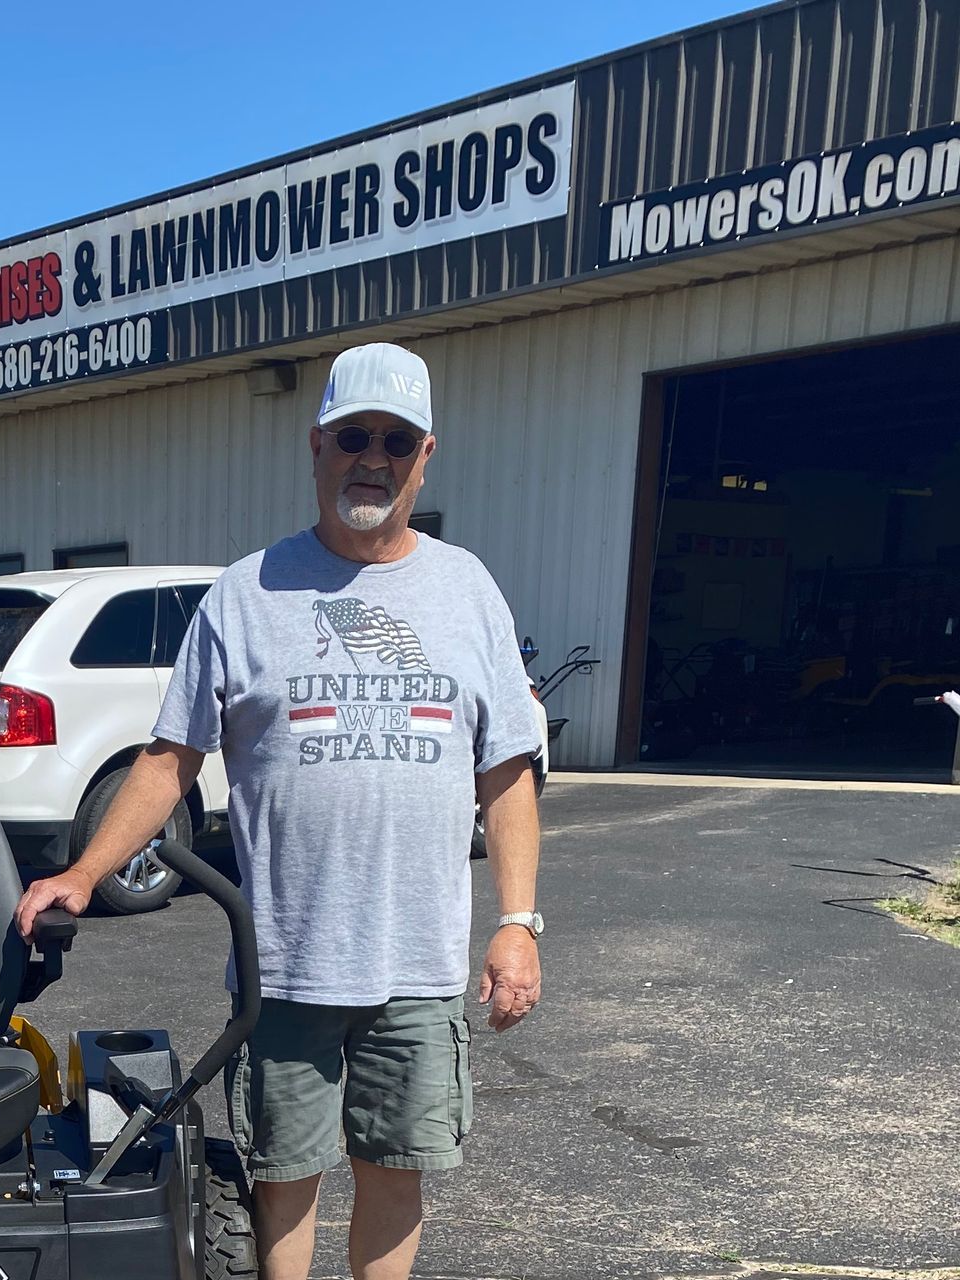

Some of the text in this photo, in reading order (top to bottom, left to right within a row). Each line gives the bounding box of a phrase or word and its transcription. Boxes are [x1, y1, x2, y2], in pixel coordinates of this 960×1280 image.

[73, 239, 102, 308] &
[110, 162, 381, 299] LAWNMOWER
[393, 112, 558, 229] SHOPS
[608, 137, 960, 262] MowersOK.com
[286, 673, 459, 703] UNITED
[338, 704, 409, 733] WE
[299, 733, 442, 766] STAND
